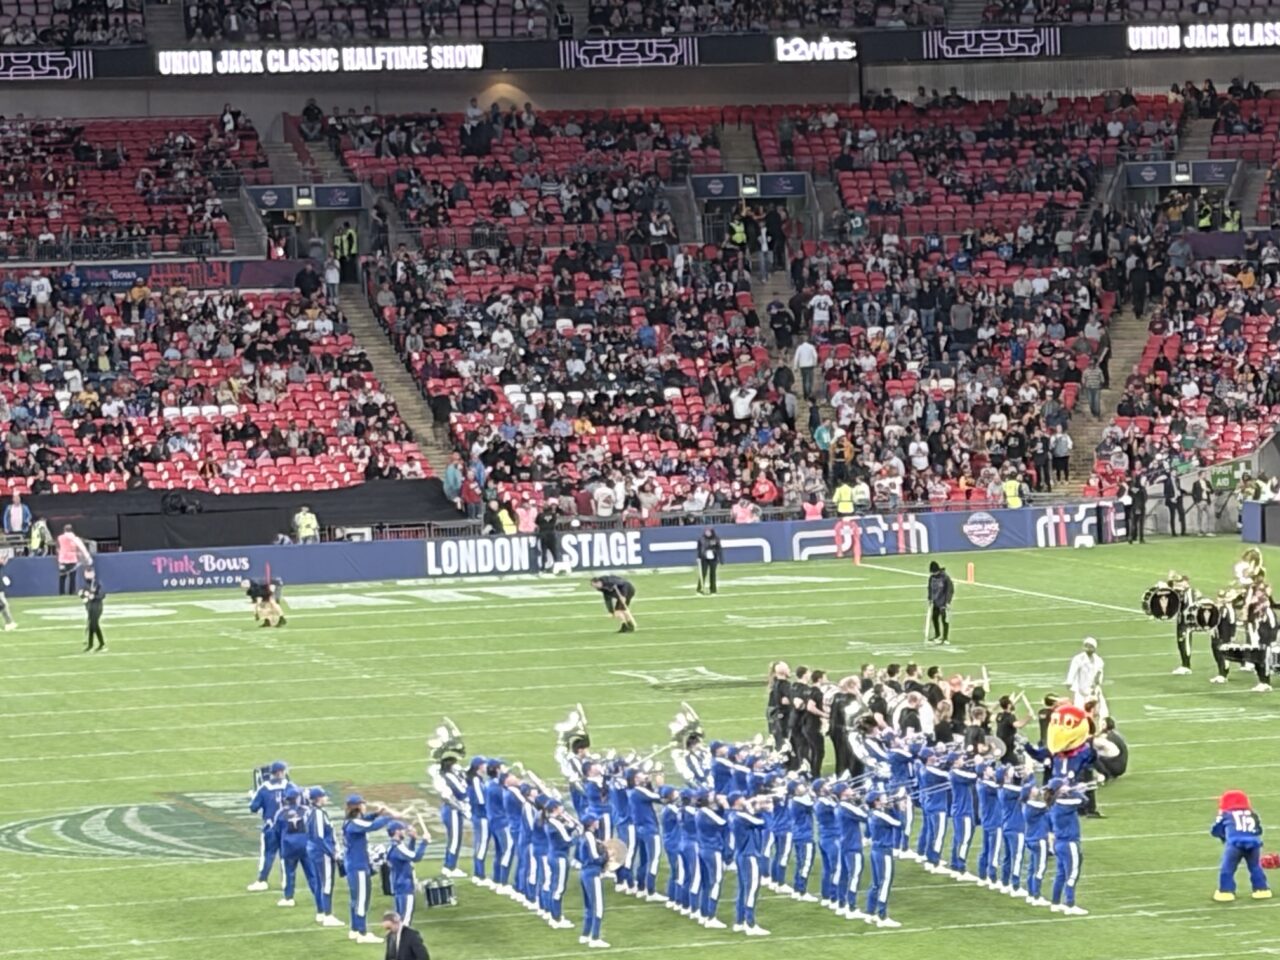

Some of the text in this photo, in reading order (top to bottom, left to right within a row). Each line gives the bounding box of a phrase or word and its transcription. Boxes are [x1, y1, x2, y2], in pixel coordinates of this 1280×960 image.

[776, 33, 858, 61] b2wins
[1127, 25, 1180, 50] UNION
[1184, 24, 1230, 49] JACK
[158, 44, 484, 75] UNION JACK CLASSIC HALFTIME SHOW
[1216, 477, 1230, 488] AID
[561, 531, 642, 568] STAGE
[152, 553, 250, 576] Pink Bows
[162, 575, 242, 588] FOUNDATION
